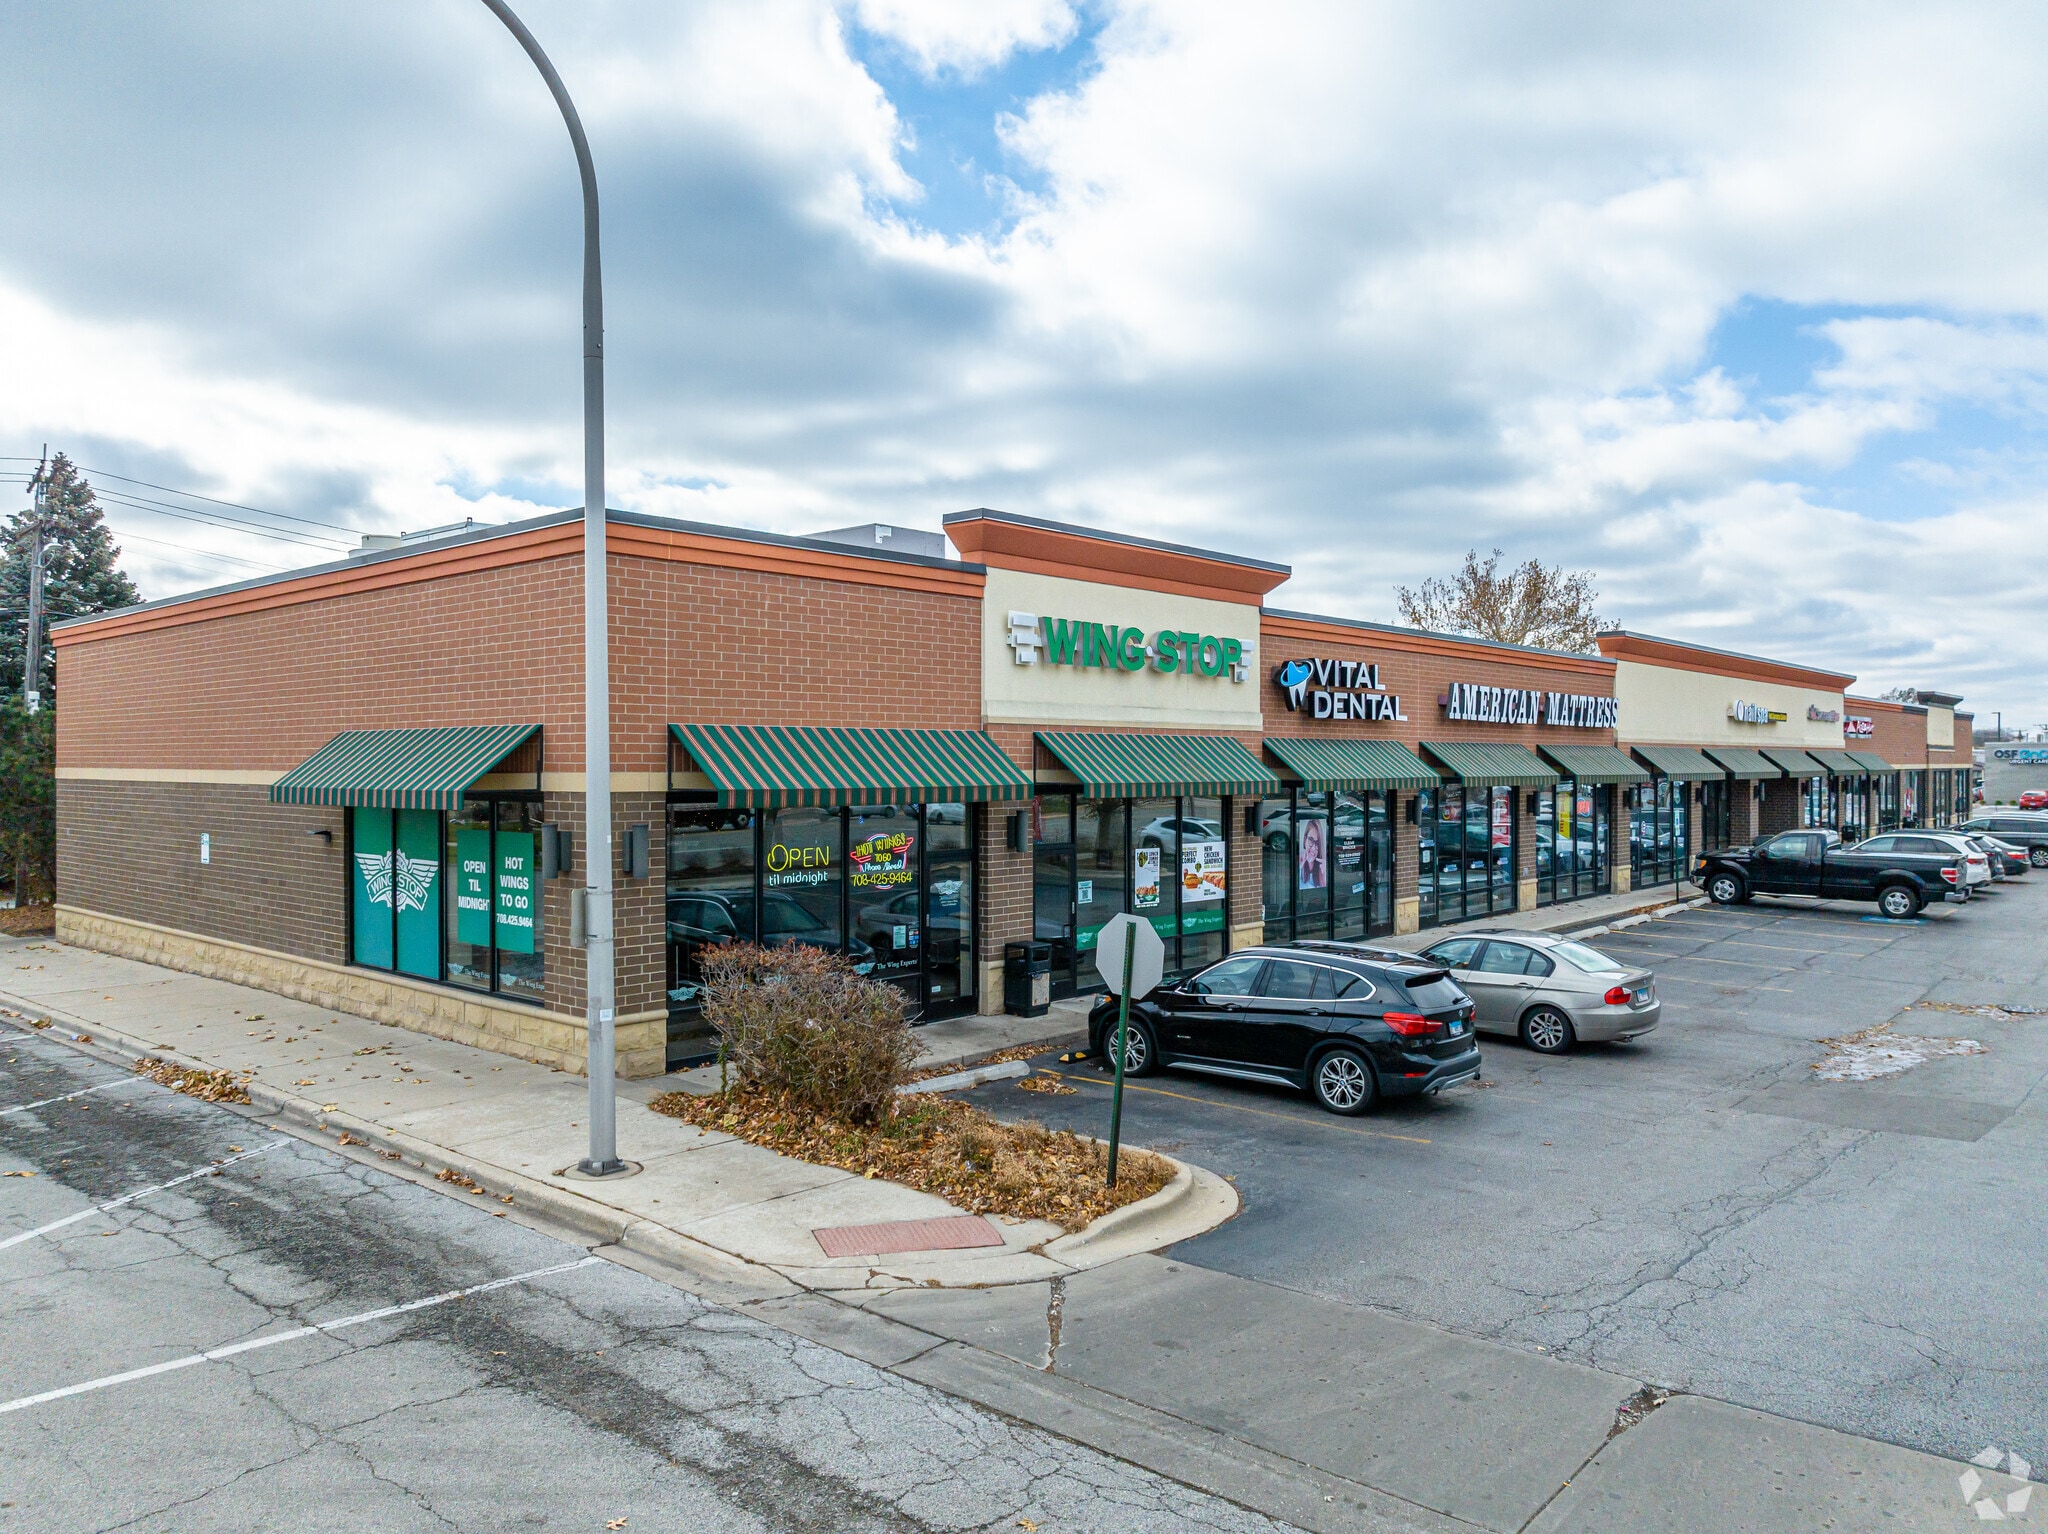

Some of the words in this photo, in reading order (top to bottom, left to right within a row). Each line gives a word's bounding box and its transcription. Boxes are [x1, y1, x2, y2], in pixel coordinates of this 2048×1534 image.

[1313, 658, 1386, 691] VITAL
[1309, 691, 1408, 722] DENTAL
[1447, 682, 1541, 726] AMERICAN
[1546, 692, 1619, 729] MATTRESS
[1994, 749, 2018, 758] OSF
[505, 856, 523, 870] HOT
[767, 844, 830, 872] OPEN
[464, 859, 486, 874] OPEN
[468, 879, 481, 892] TIL
[500, 874, 529, 890] WINGS
[768, 872, 780, 886] til
[783, 871, 828, 886] midnight
[851, 871, 912, 887] 708-425-9464
[398, 875, 423, 898] STOP
[458, 896, 490, 911] MIDNIGH
[500, 894, 513, 907] TO
[514, 895, 528, 909] GO
[496, 912, 533, 928] 708.425.9464
[877, 962, 886, 970] The
[887, 961, 899, 969] Wing
